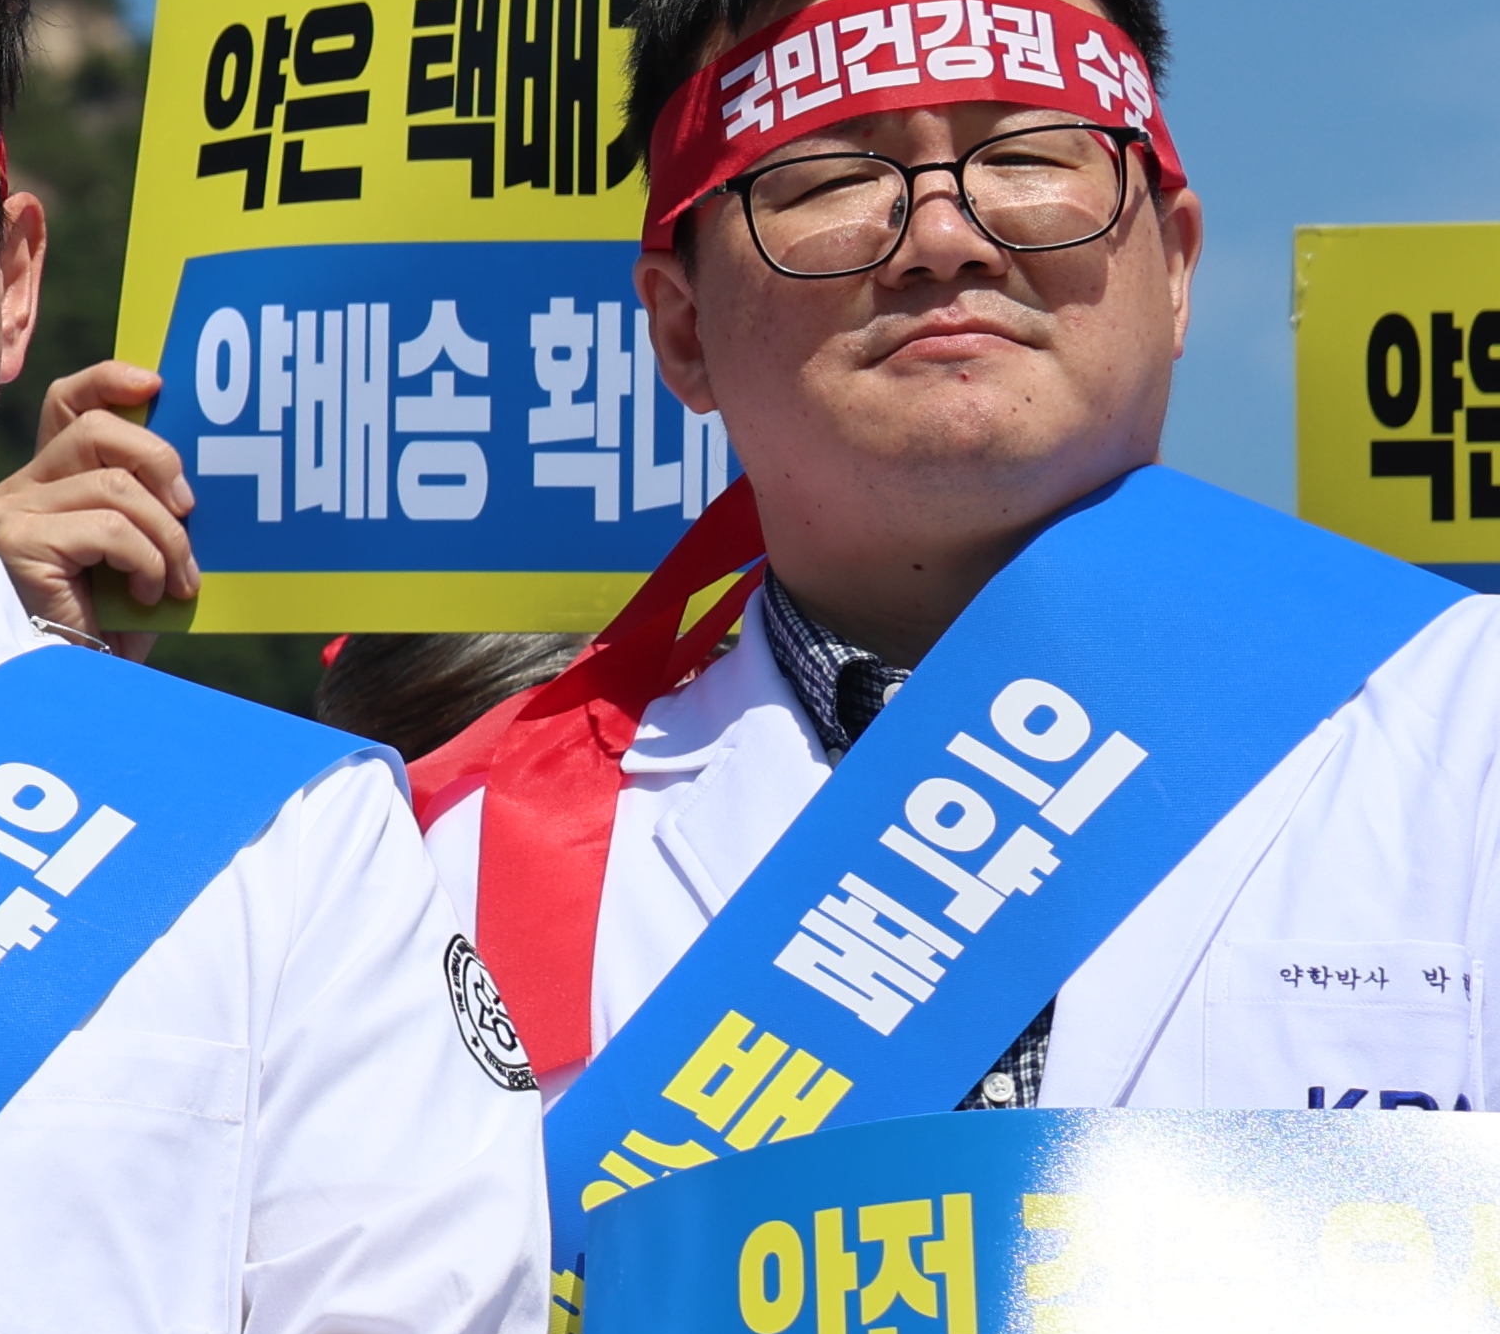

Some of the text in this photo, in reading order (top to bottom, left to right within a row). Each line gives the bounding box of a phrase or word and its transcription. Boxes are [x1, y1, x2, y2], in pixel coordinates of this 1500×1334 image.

[195, 2, 374, 212] 약은
[720, 0, 1154, 141] 국민건강권 수호
[194, 298, 491, 523] 약배송
[772, 676, 1149, 1037] 의약품
[1279, 963, 1391, 992] 약학박사
[1422, 965, 1452, 995] 박
